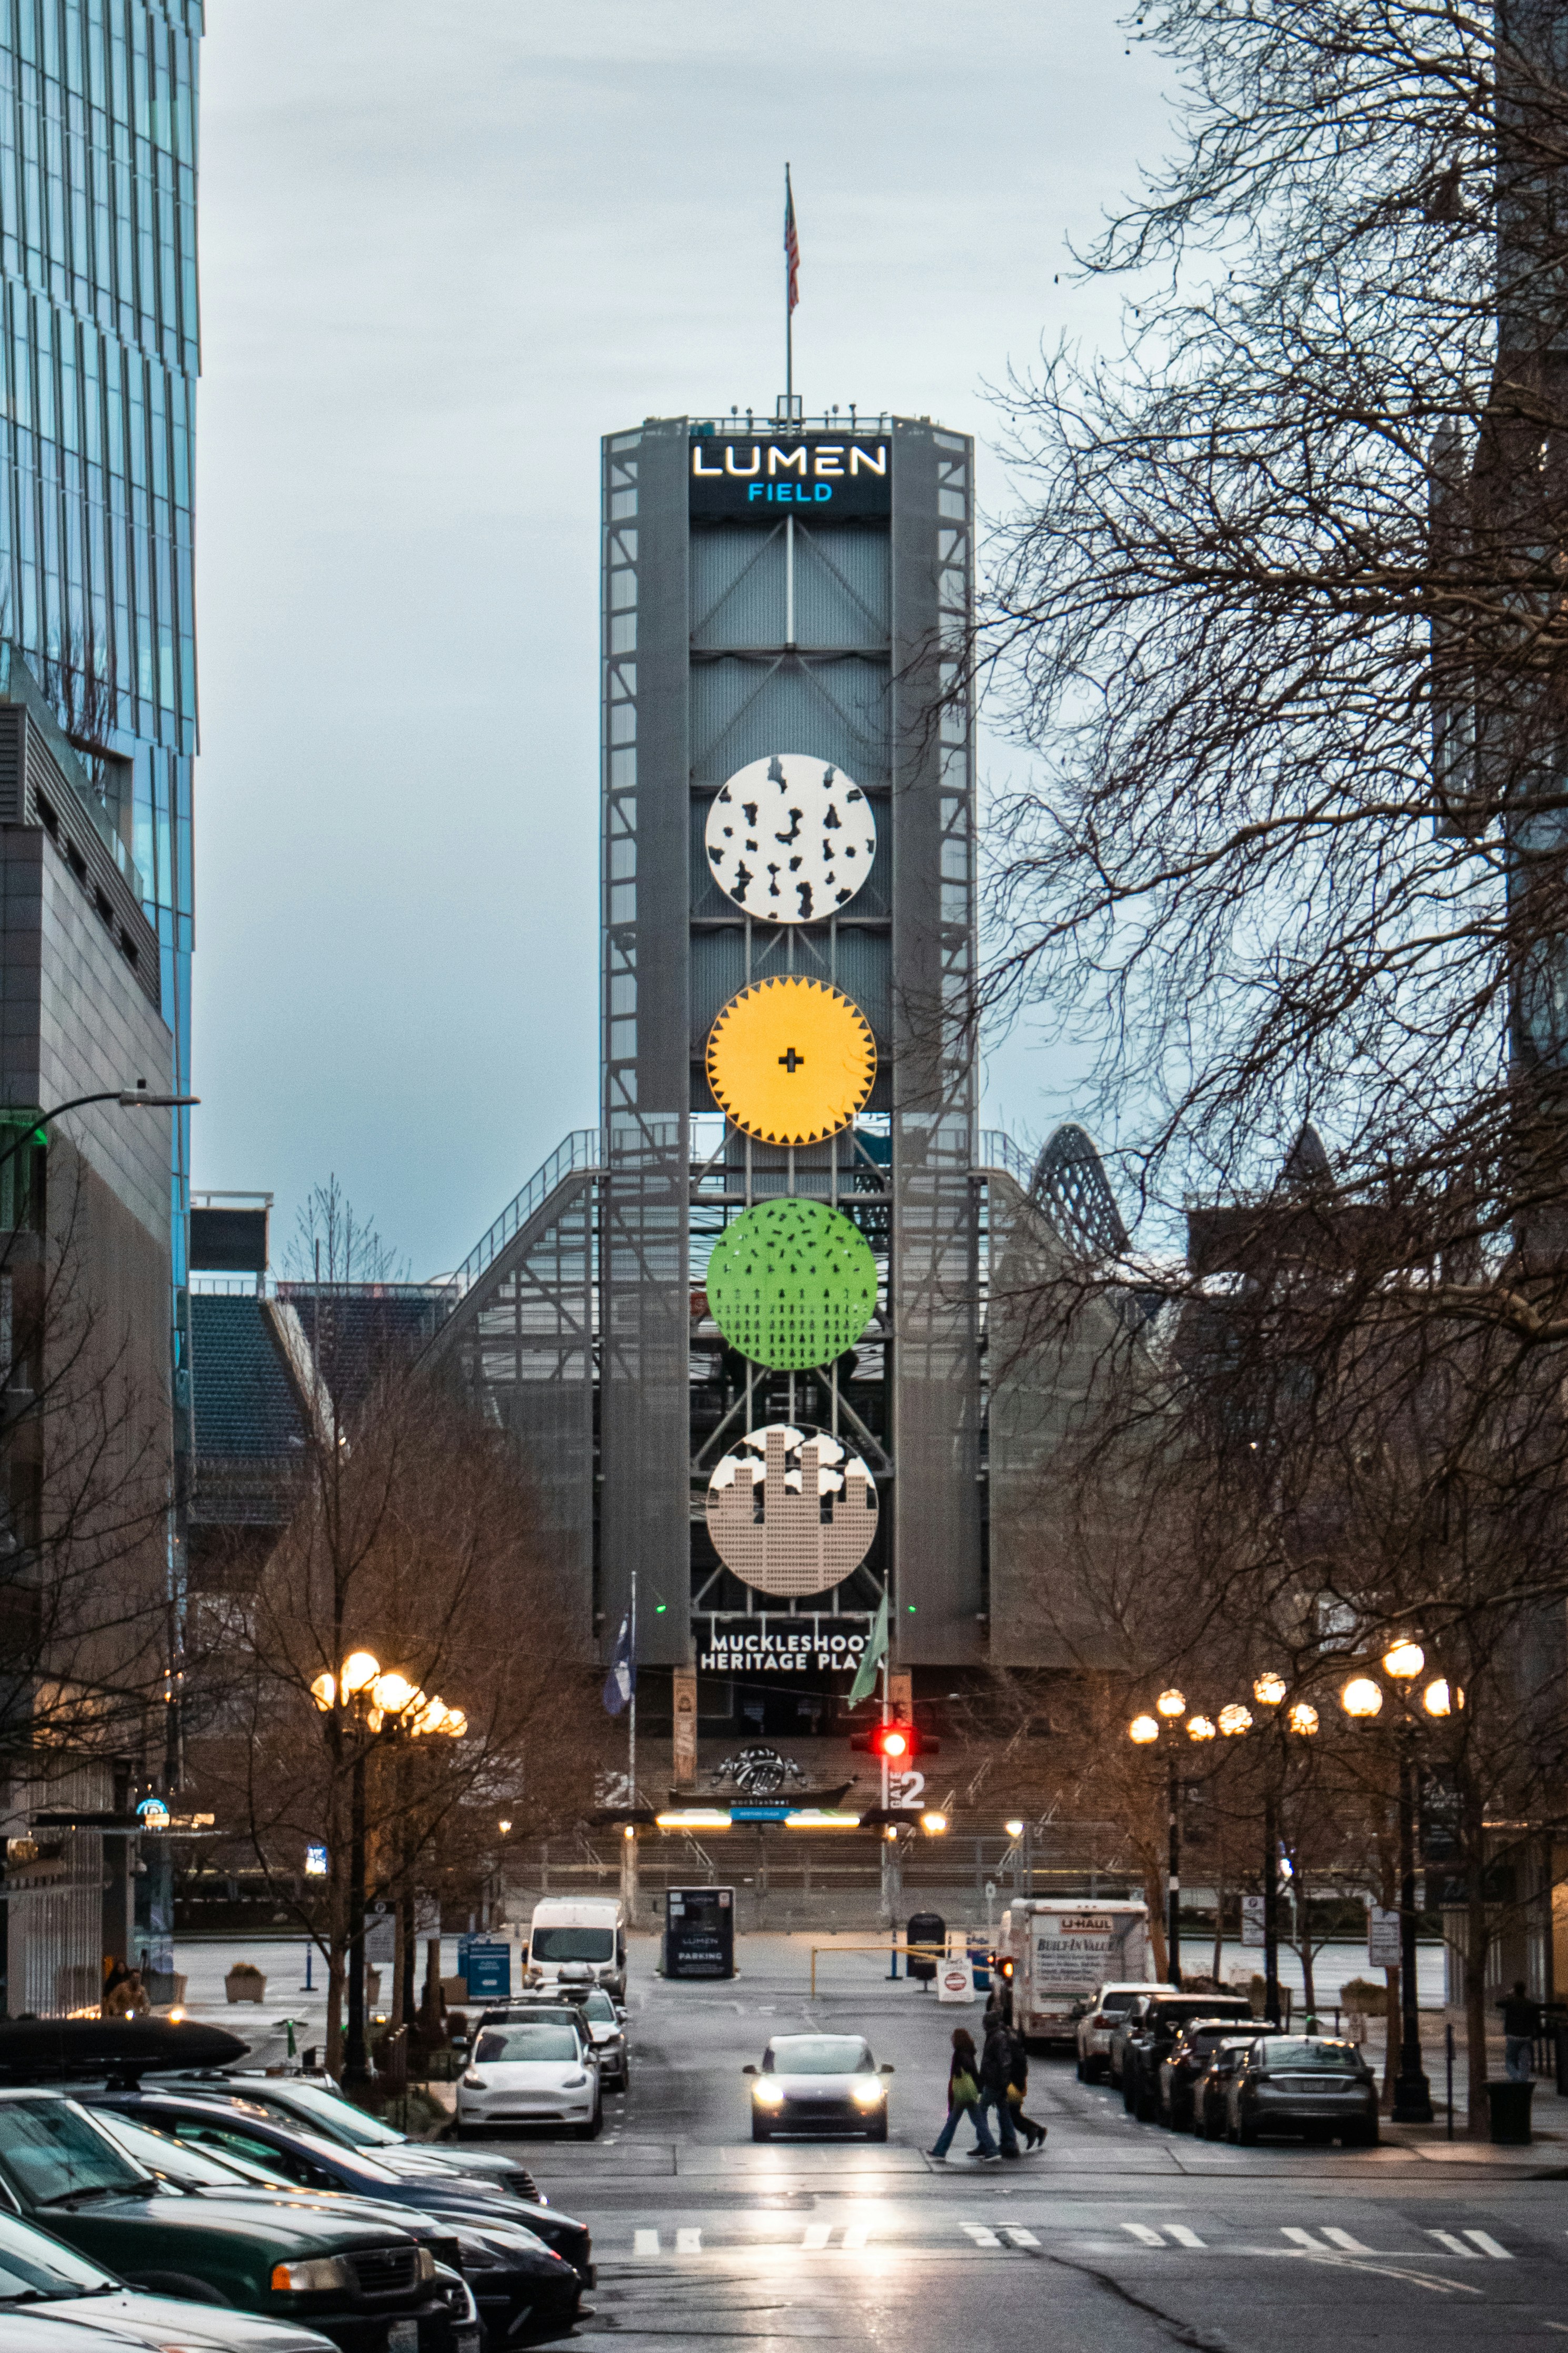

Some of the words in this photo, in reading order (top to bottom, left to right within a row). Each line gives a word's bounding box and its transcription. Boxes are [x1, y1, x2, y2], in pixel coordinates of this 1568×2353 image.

[693, 445, 886, 475] LUMEN
[748, 483, 833, 502] FIELD
[701, 1653, 807, 1670] HERITAGE
[818, 1653, 885, 1670] PLA
[890, 1771, 902, 1809] GATE
[901, 1771, 925, 1809] 2
